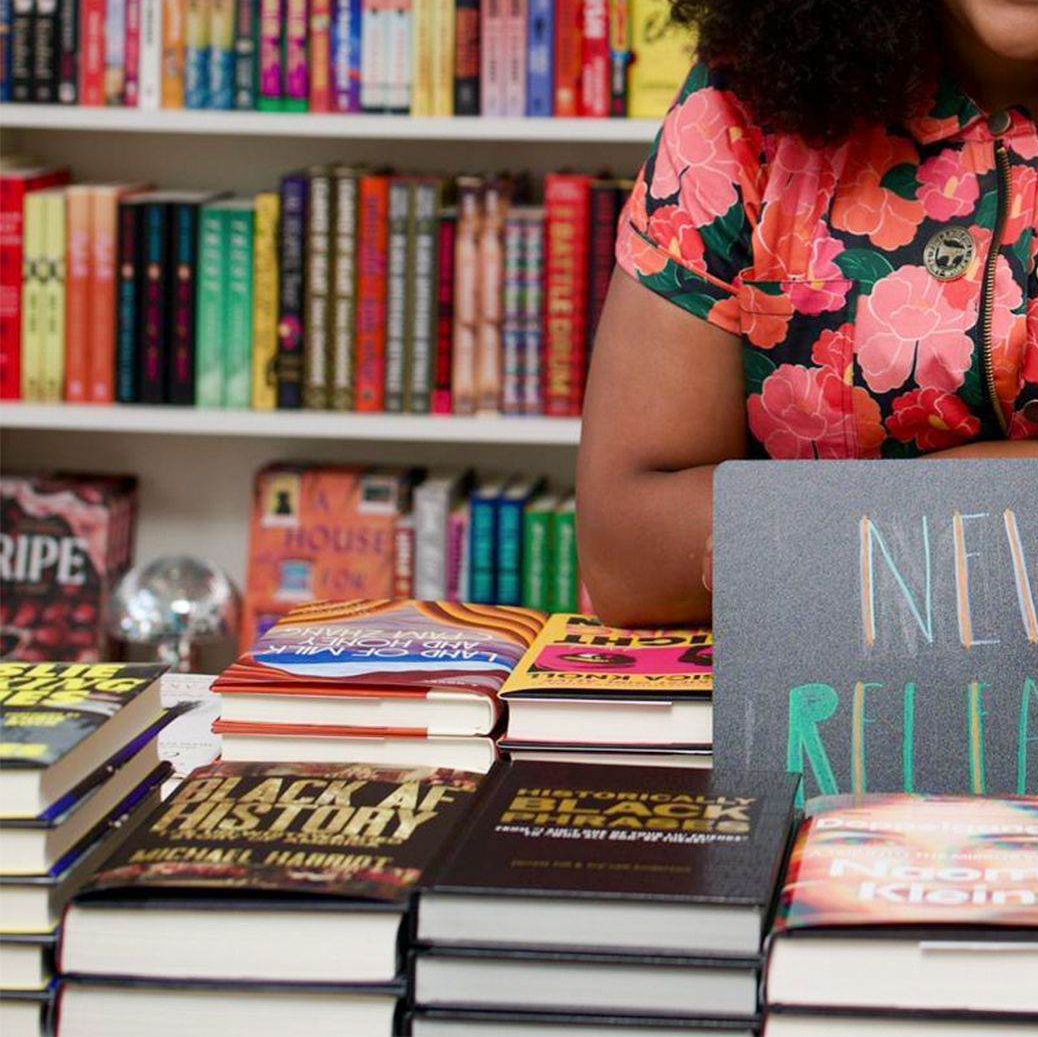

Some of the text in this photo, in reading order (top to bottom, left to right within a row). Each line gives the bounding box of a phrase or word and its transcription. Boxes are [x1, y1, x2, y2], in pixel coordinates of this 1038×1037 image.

[285, 524, 388, 555] HOUSE
[321, 566, 364, 589] FOR
[281, 626, 386, 638] ZHANG
[297, 635, 481, 650] AND HONEY
[554, 634, 713, 647] IGHT
[267, 644, 500, 662] LAND OF MILK
[509, 672, 632, 682] KNOLL
[169, 777, 455, 812] BLACK AF
[516, 787, 756, 806] HISTORICALLY
[507, 796, 751, 821] BLACK
[149, 802, 438, 842] HISTORY
[500, 812, 751, 833] PHRASES
[130, 846, 395, 870] MICHAEL HARRIOT
[857, 881, 1037, 906] Klein
